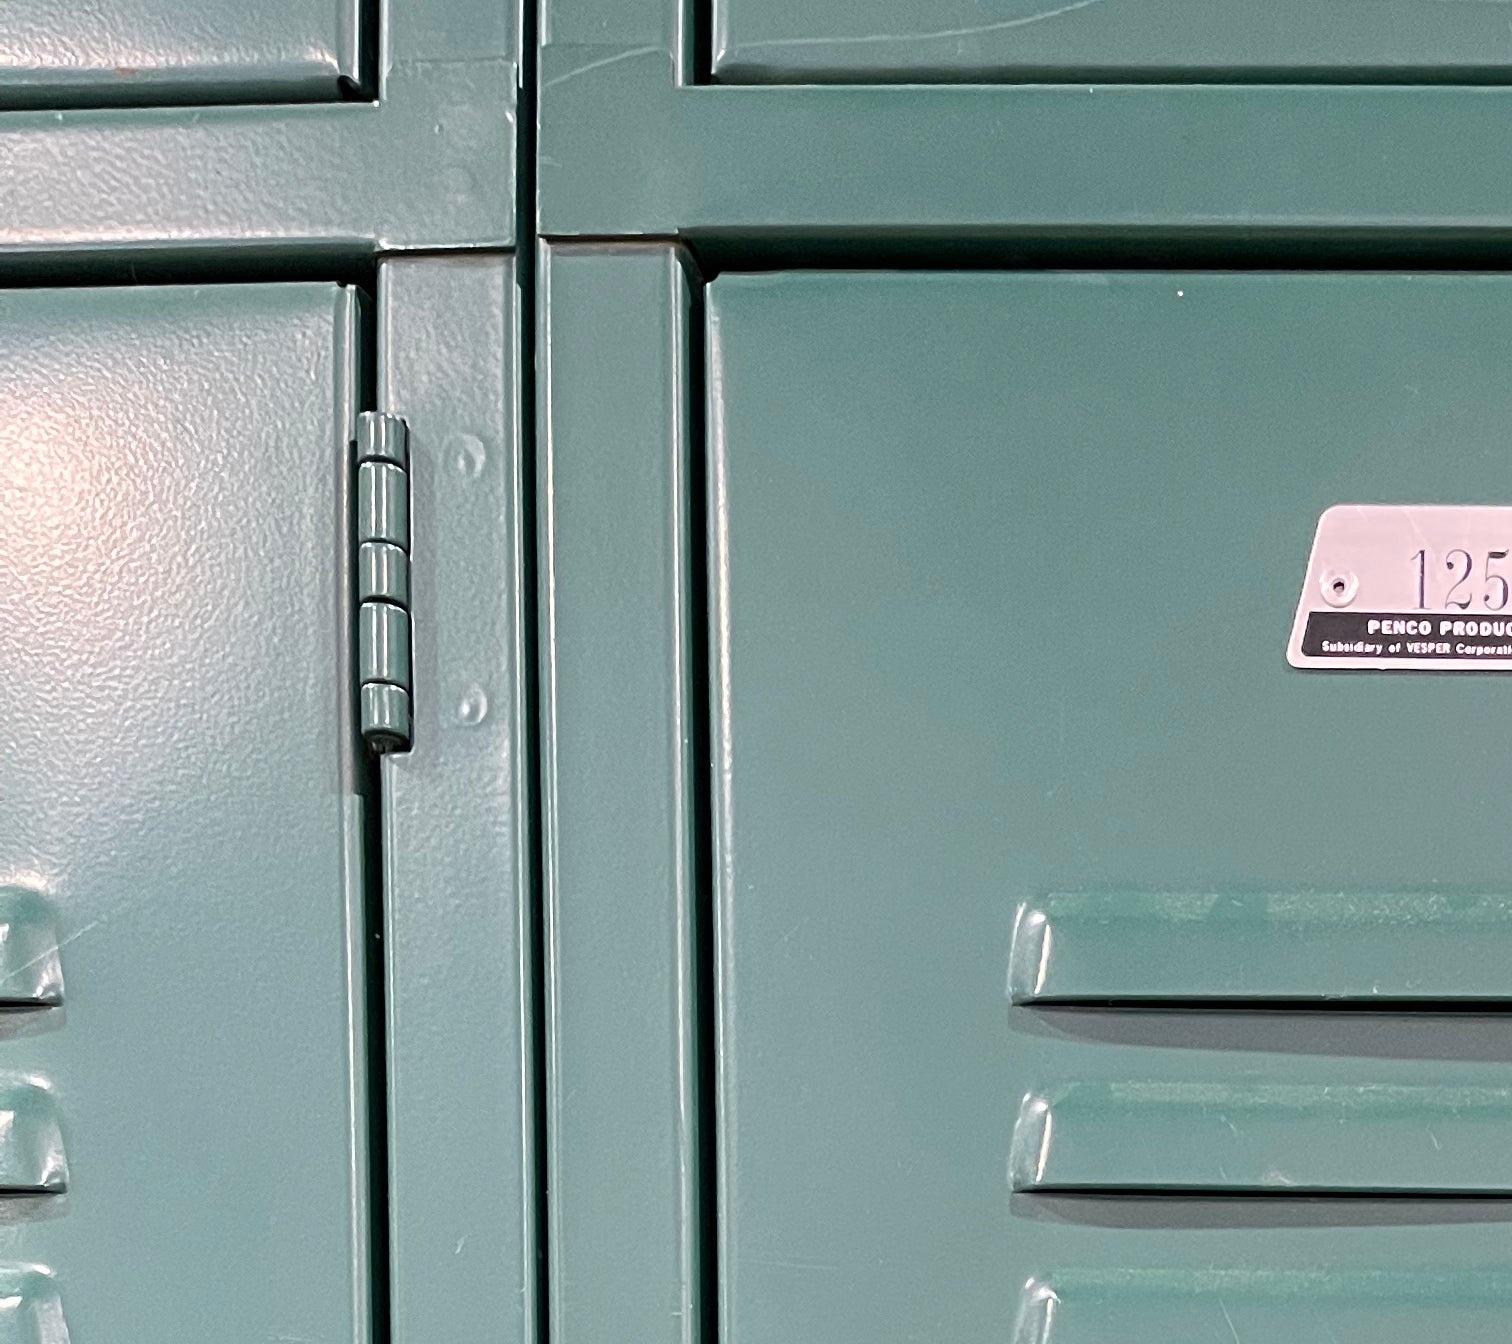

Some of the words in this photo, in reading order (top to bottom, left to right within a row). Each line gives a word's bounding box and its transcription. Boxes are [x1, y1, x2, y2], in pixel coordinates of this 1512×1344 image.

[1366, 619, 1433, 636] PENCO
[1321, 640, 1383, 655] Subsidiary
[1387, 642, 1401, 654] of
[1406, 642, 1452, 654] VESPER
